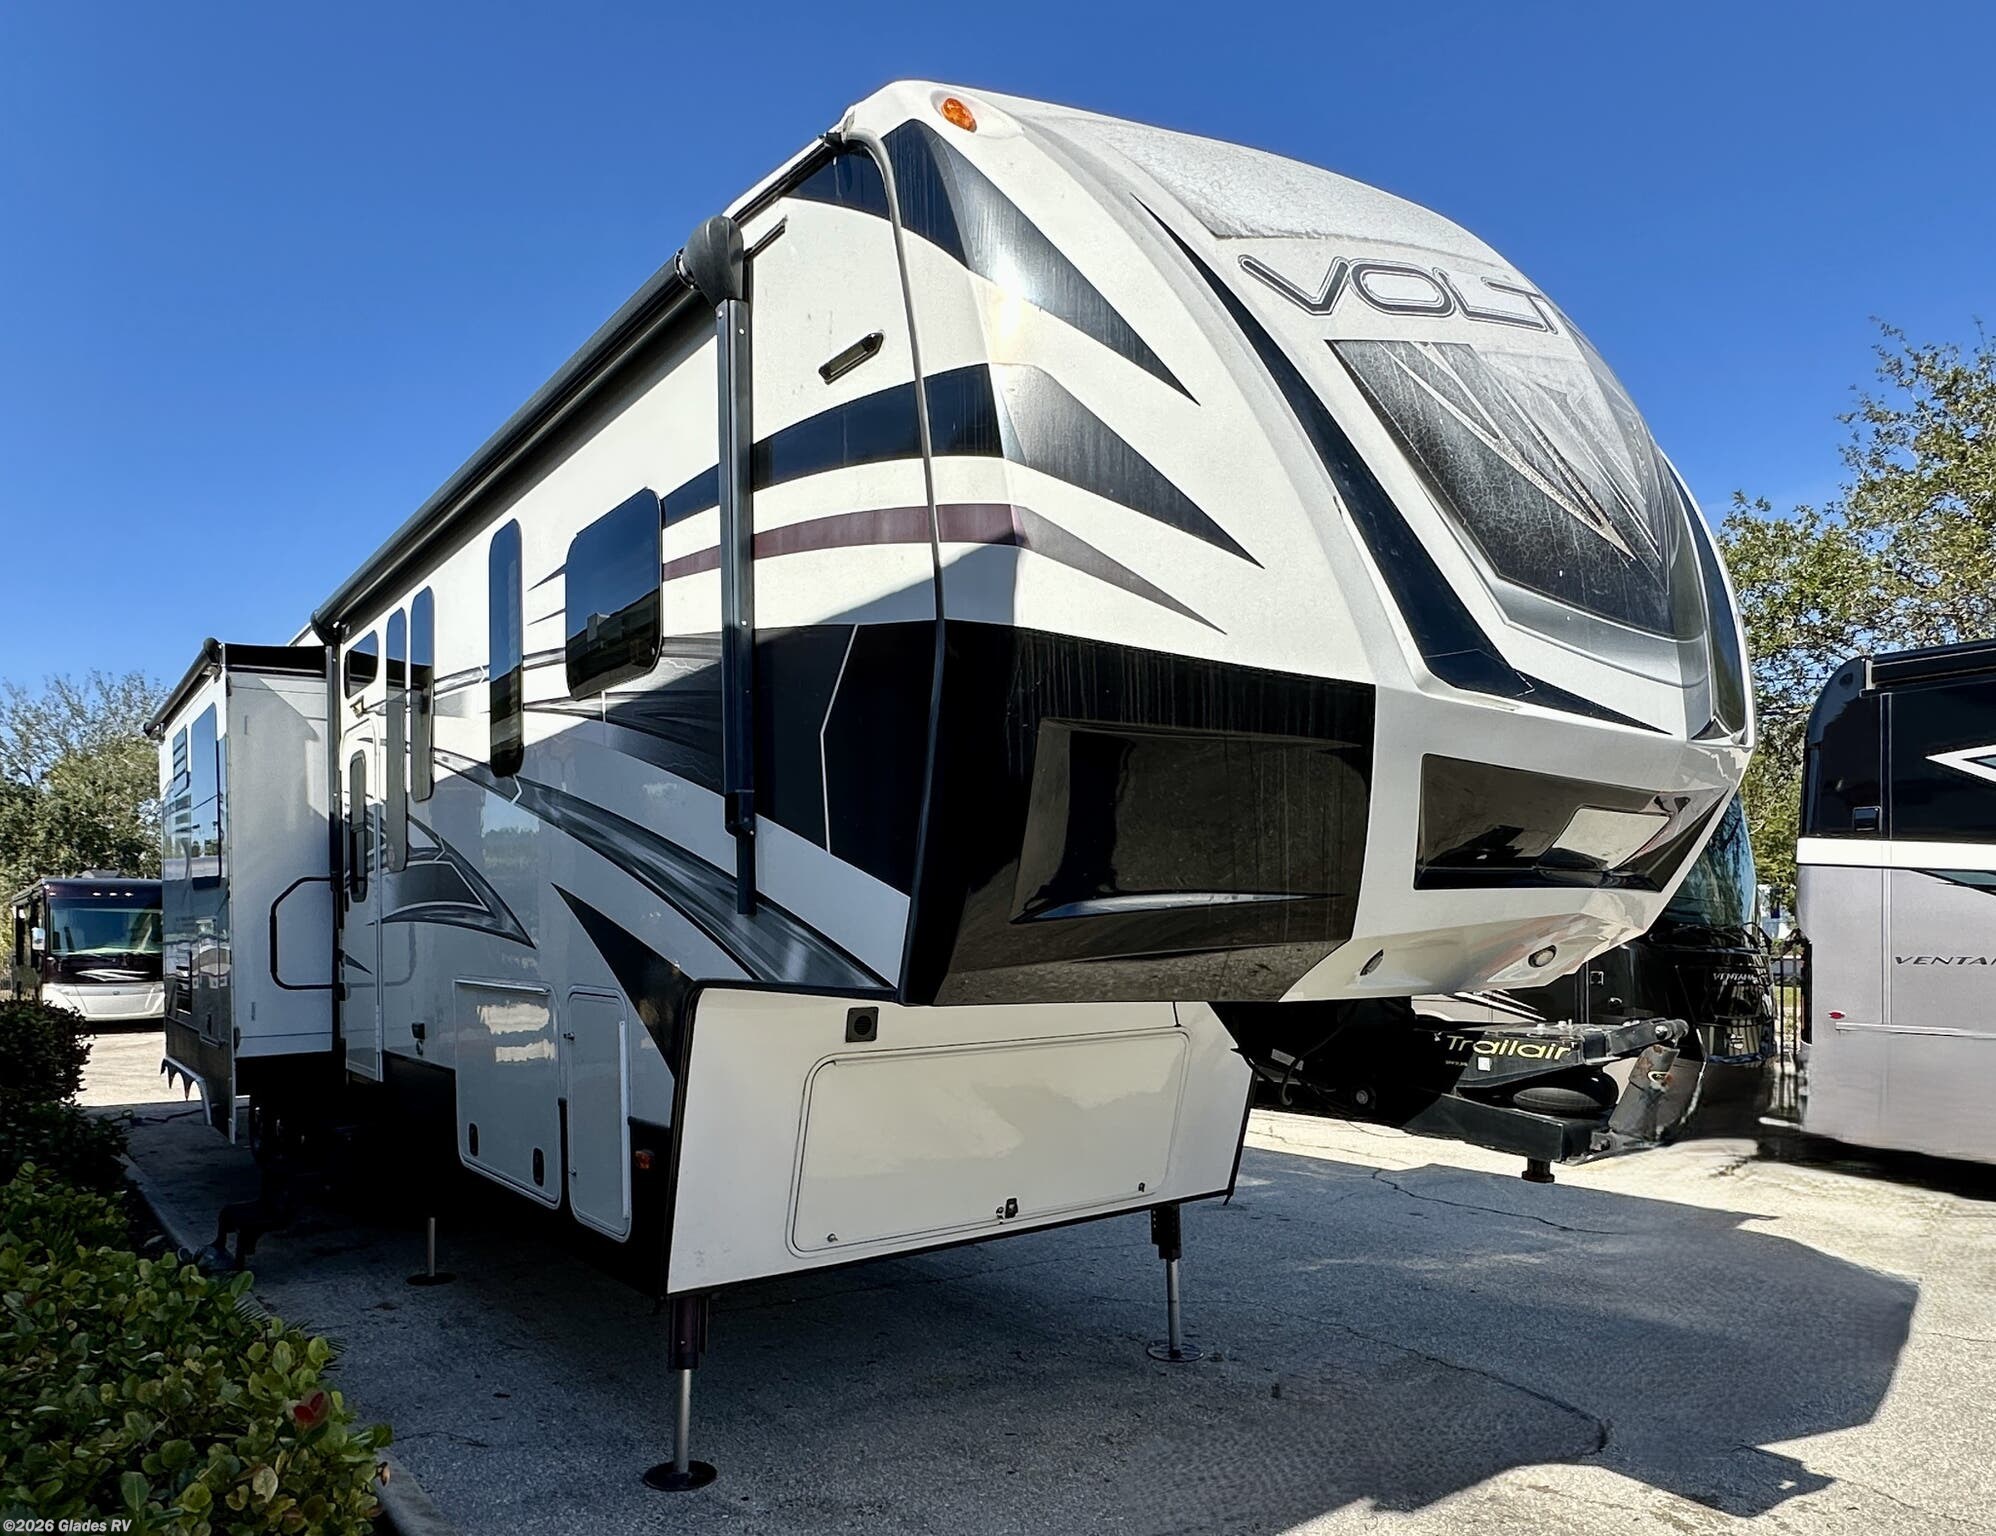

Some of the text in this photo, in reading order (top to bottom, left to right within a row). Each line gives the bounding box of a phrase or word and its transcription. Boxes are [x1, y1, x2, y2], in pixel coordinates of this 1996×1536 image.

[1237, 254, 1557, 335] VOLT
[1895, 956, 1996, 966] VENTA
[1446, 1034, 1572, 1061] Trailair
